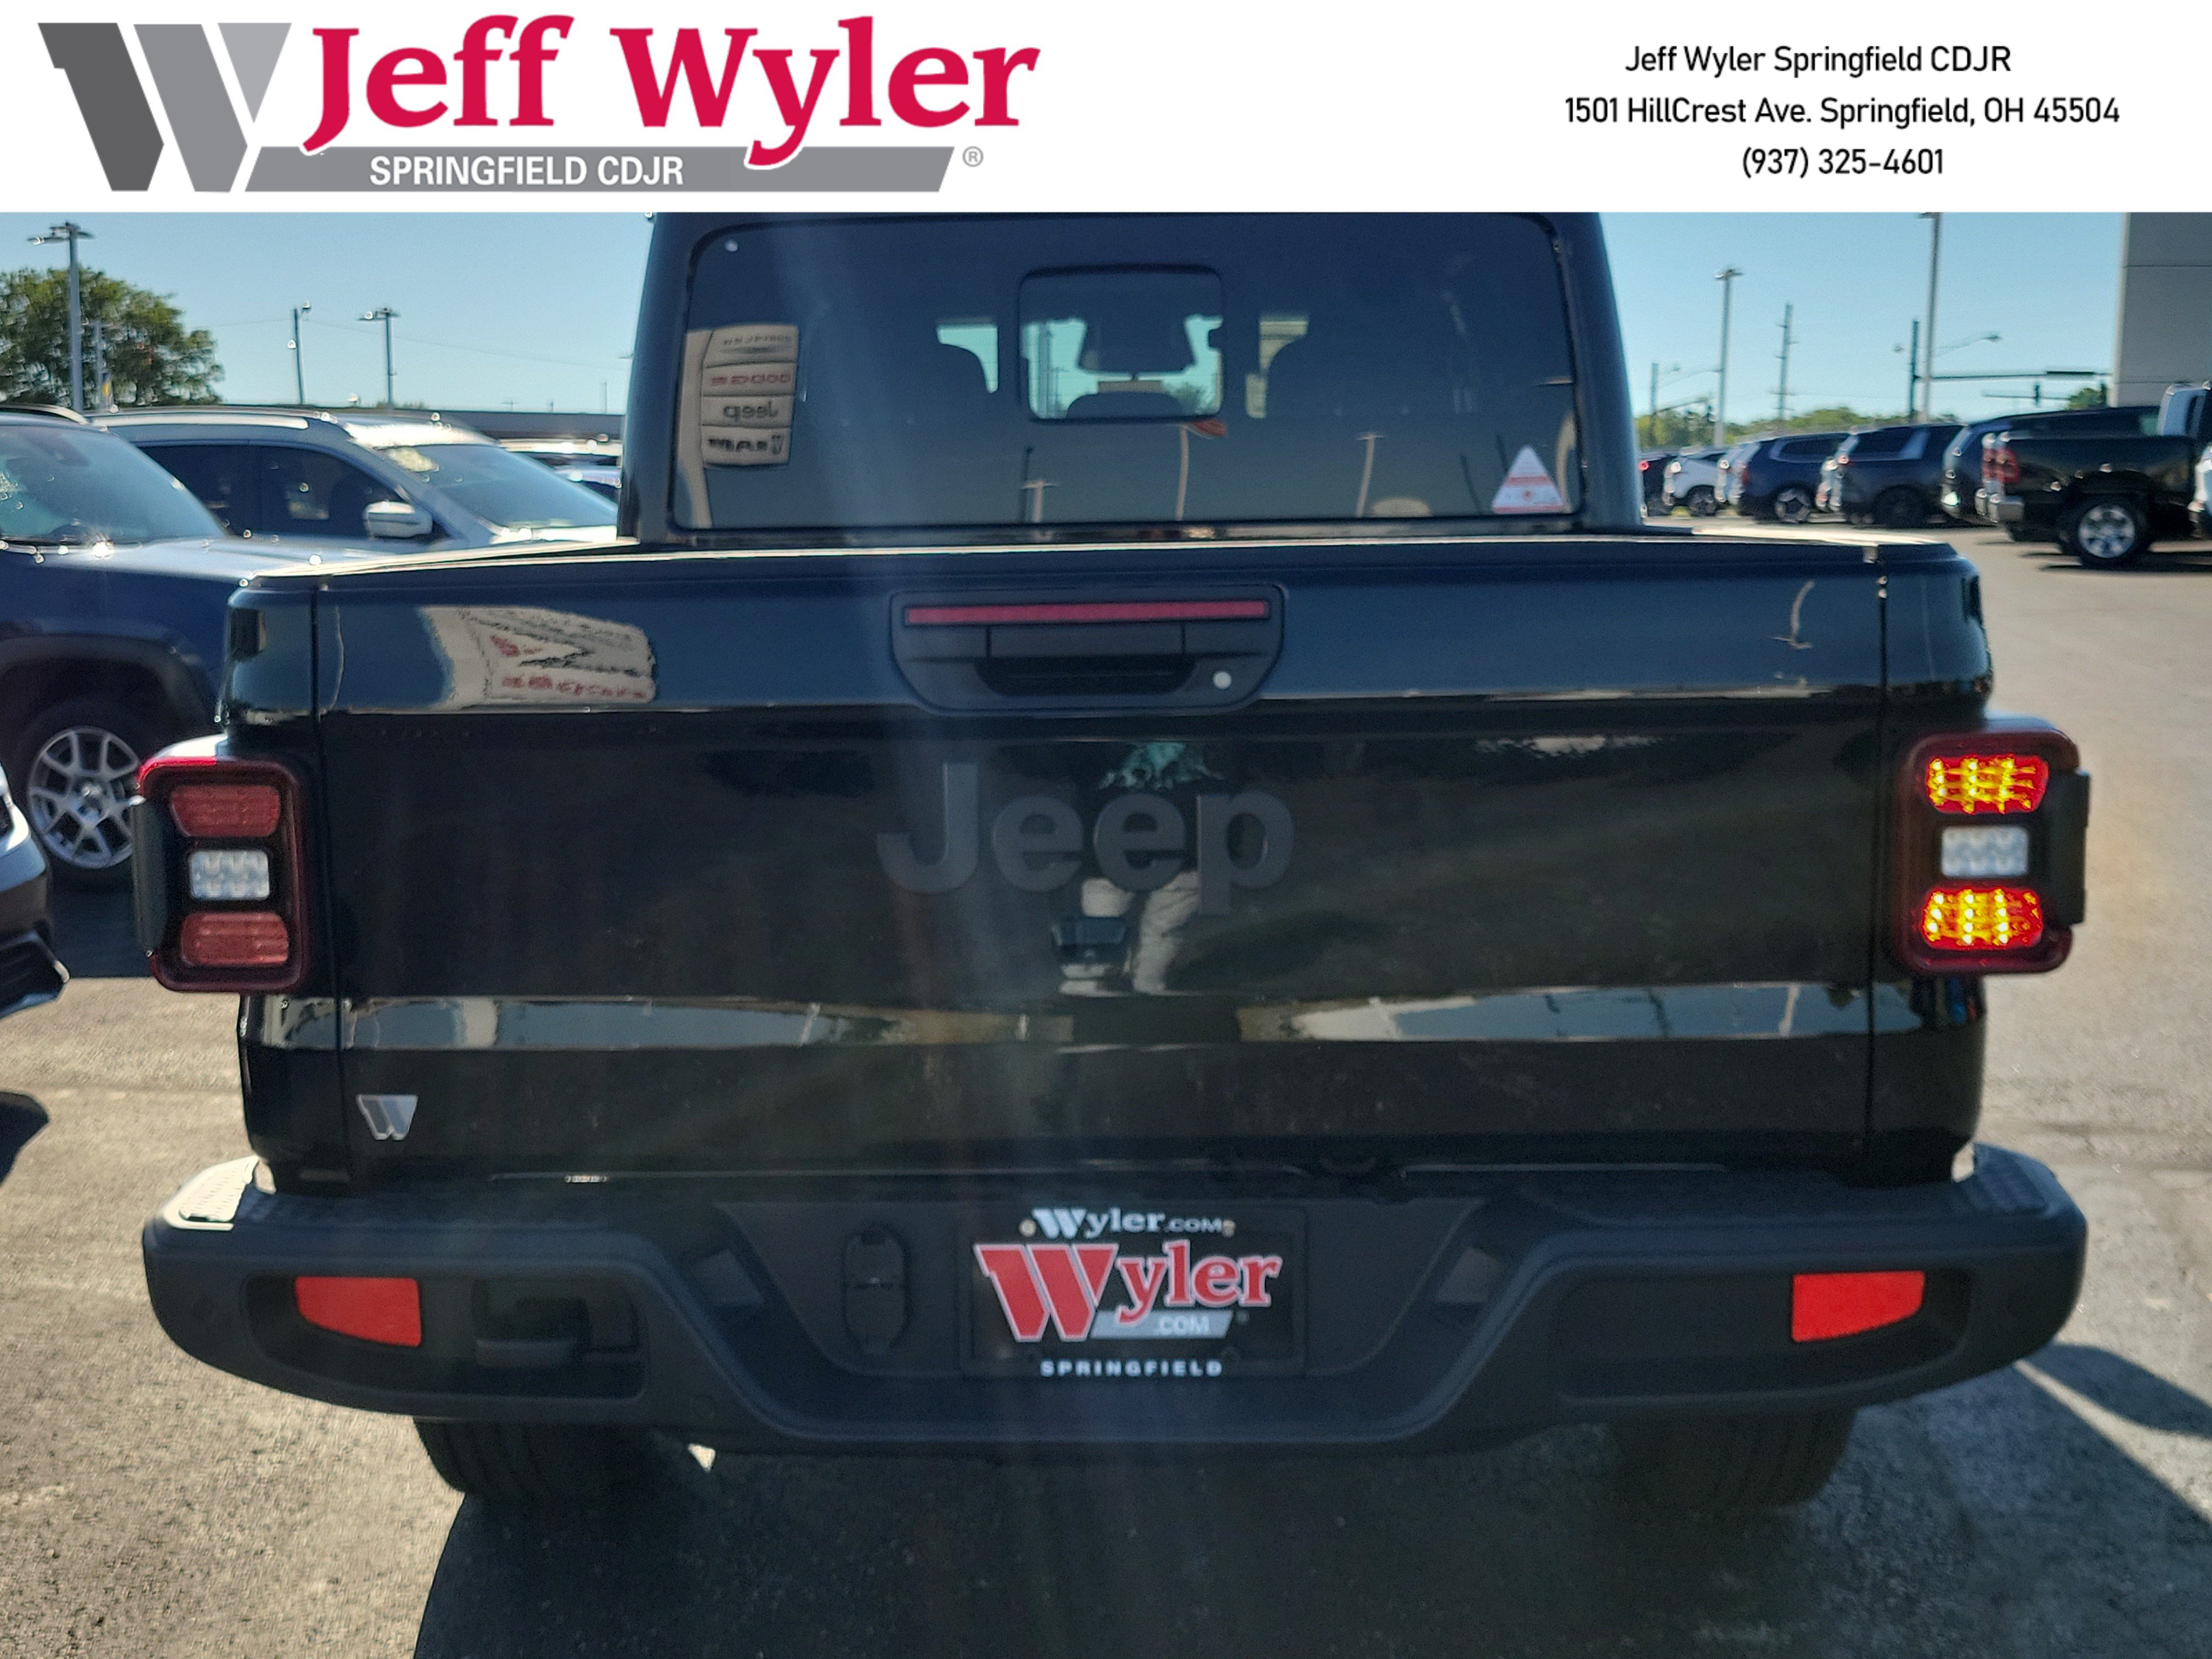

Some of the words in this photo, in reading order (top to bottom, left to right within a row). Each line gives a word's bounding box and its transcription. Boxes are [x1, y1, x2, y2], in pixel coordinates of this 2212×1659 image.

[877, 761, 1294, 915] Jeep
[974, 1239, 1284, 1343] Wyler
[1040, 1359, 1223, 1378] SPRINGFIELD
